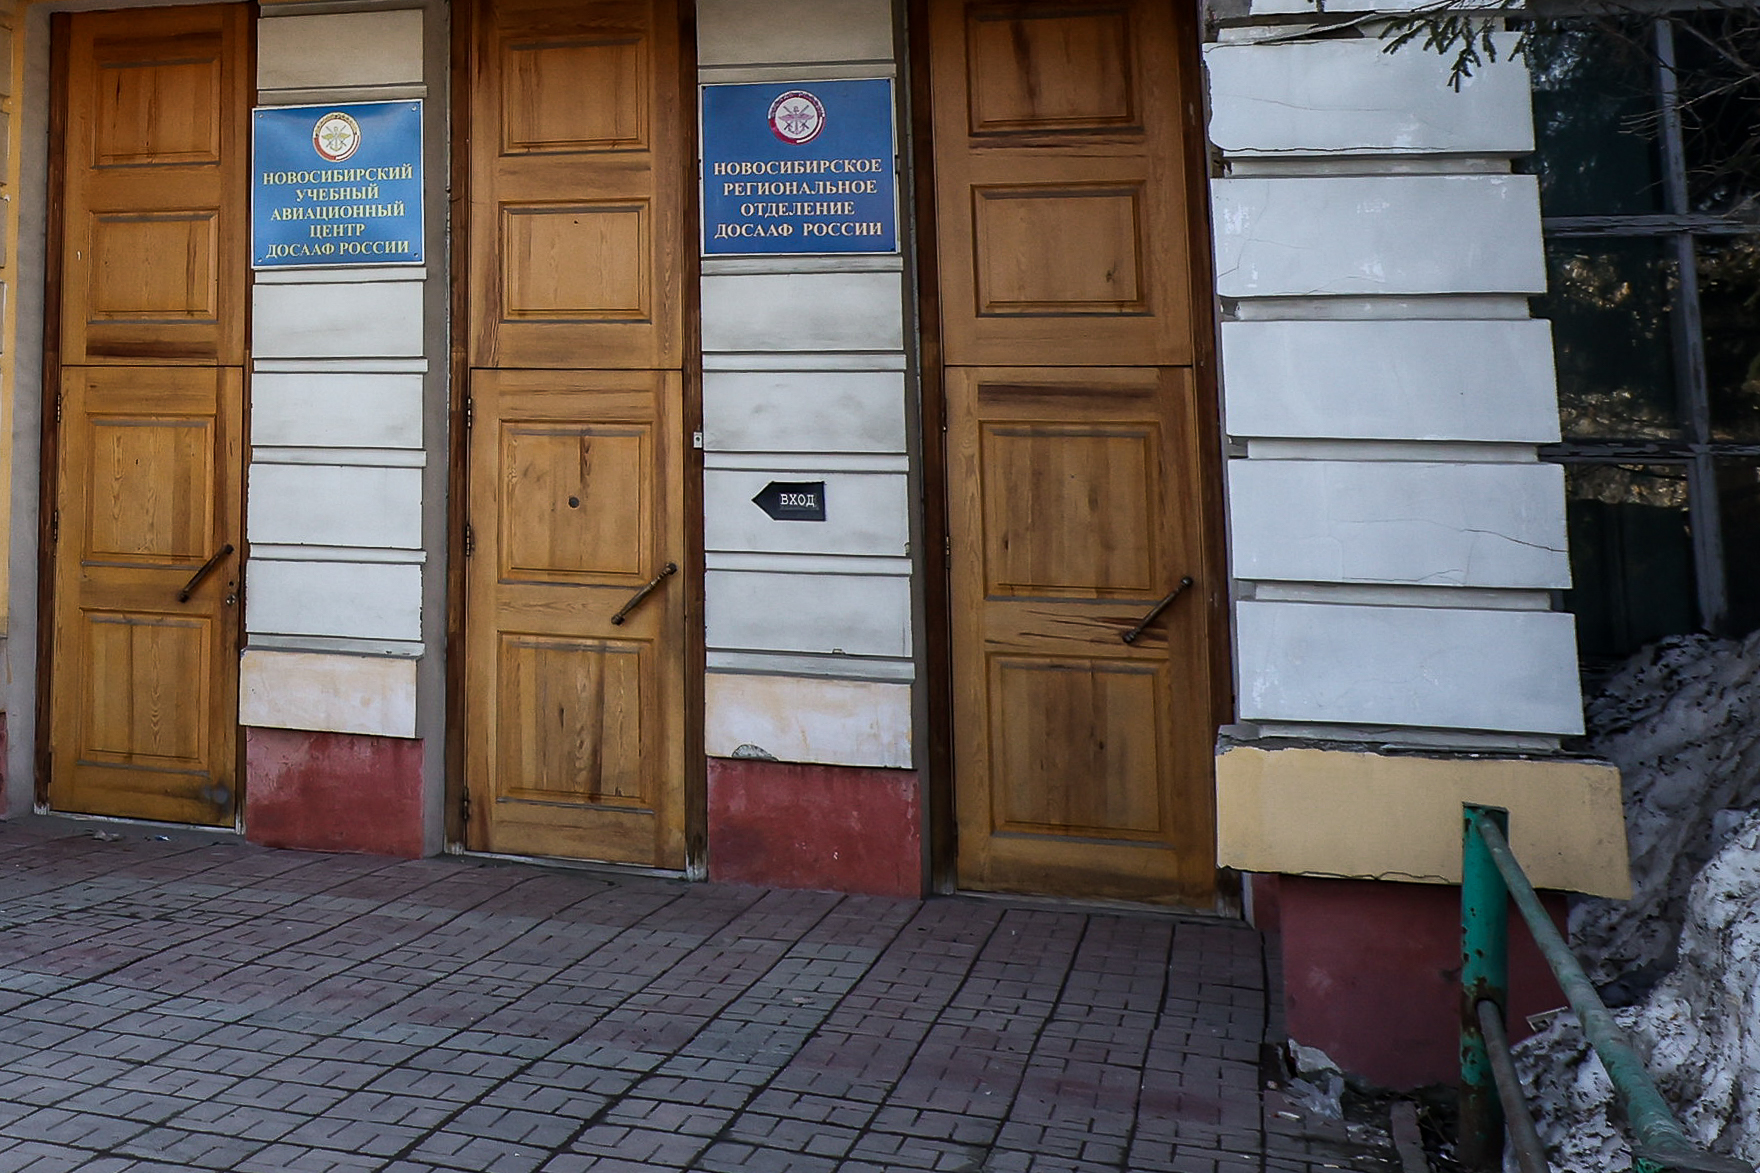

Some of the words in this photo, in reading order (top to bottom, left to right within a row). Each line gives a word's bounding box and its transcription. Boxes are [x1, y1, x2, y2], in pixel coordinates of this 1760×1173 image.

[263, 163, 413, 185] НОВОСИБИРСКИЙ
[714, 159, 882, 175] НОВОСИБИРСКОЕ
[296, 183, 379, 202] УЧЕБНЫЙ
[723, 180, 877, 196] РЕГИОНАЛЬНОЕ
[271, 201, 405, 221] АВИАЦИОННЫЙ
[740, 201, 855, 218] ОТДЕЛЕНИЕ
[310, 223, 366, 239] ЦЕНТР
[714, 223, 794, 239] ДОСААФ
[803, 222, 882, 236] РОССИИ
[266, 243, 334, 259] ДОСААФ
[340, 241, 409, 255] РОССИИ
[780, 493, 815, 507] ВХОД
